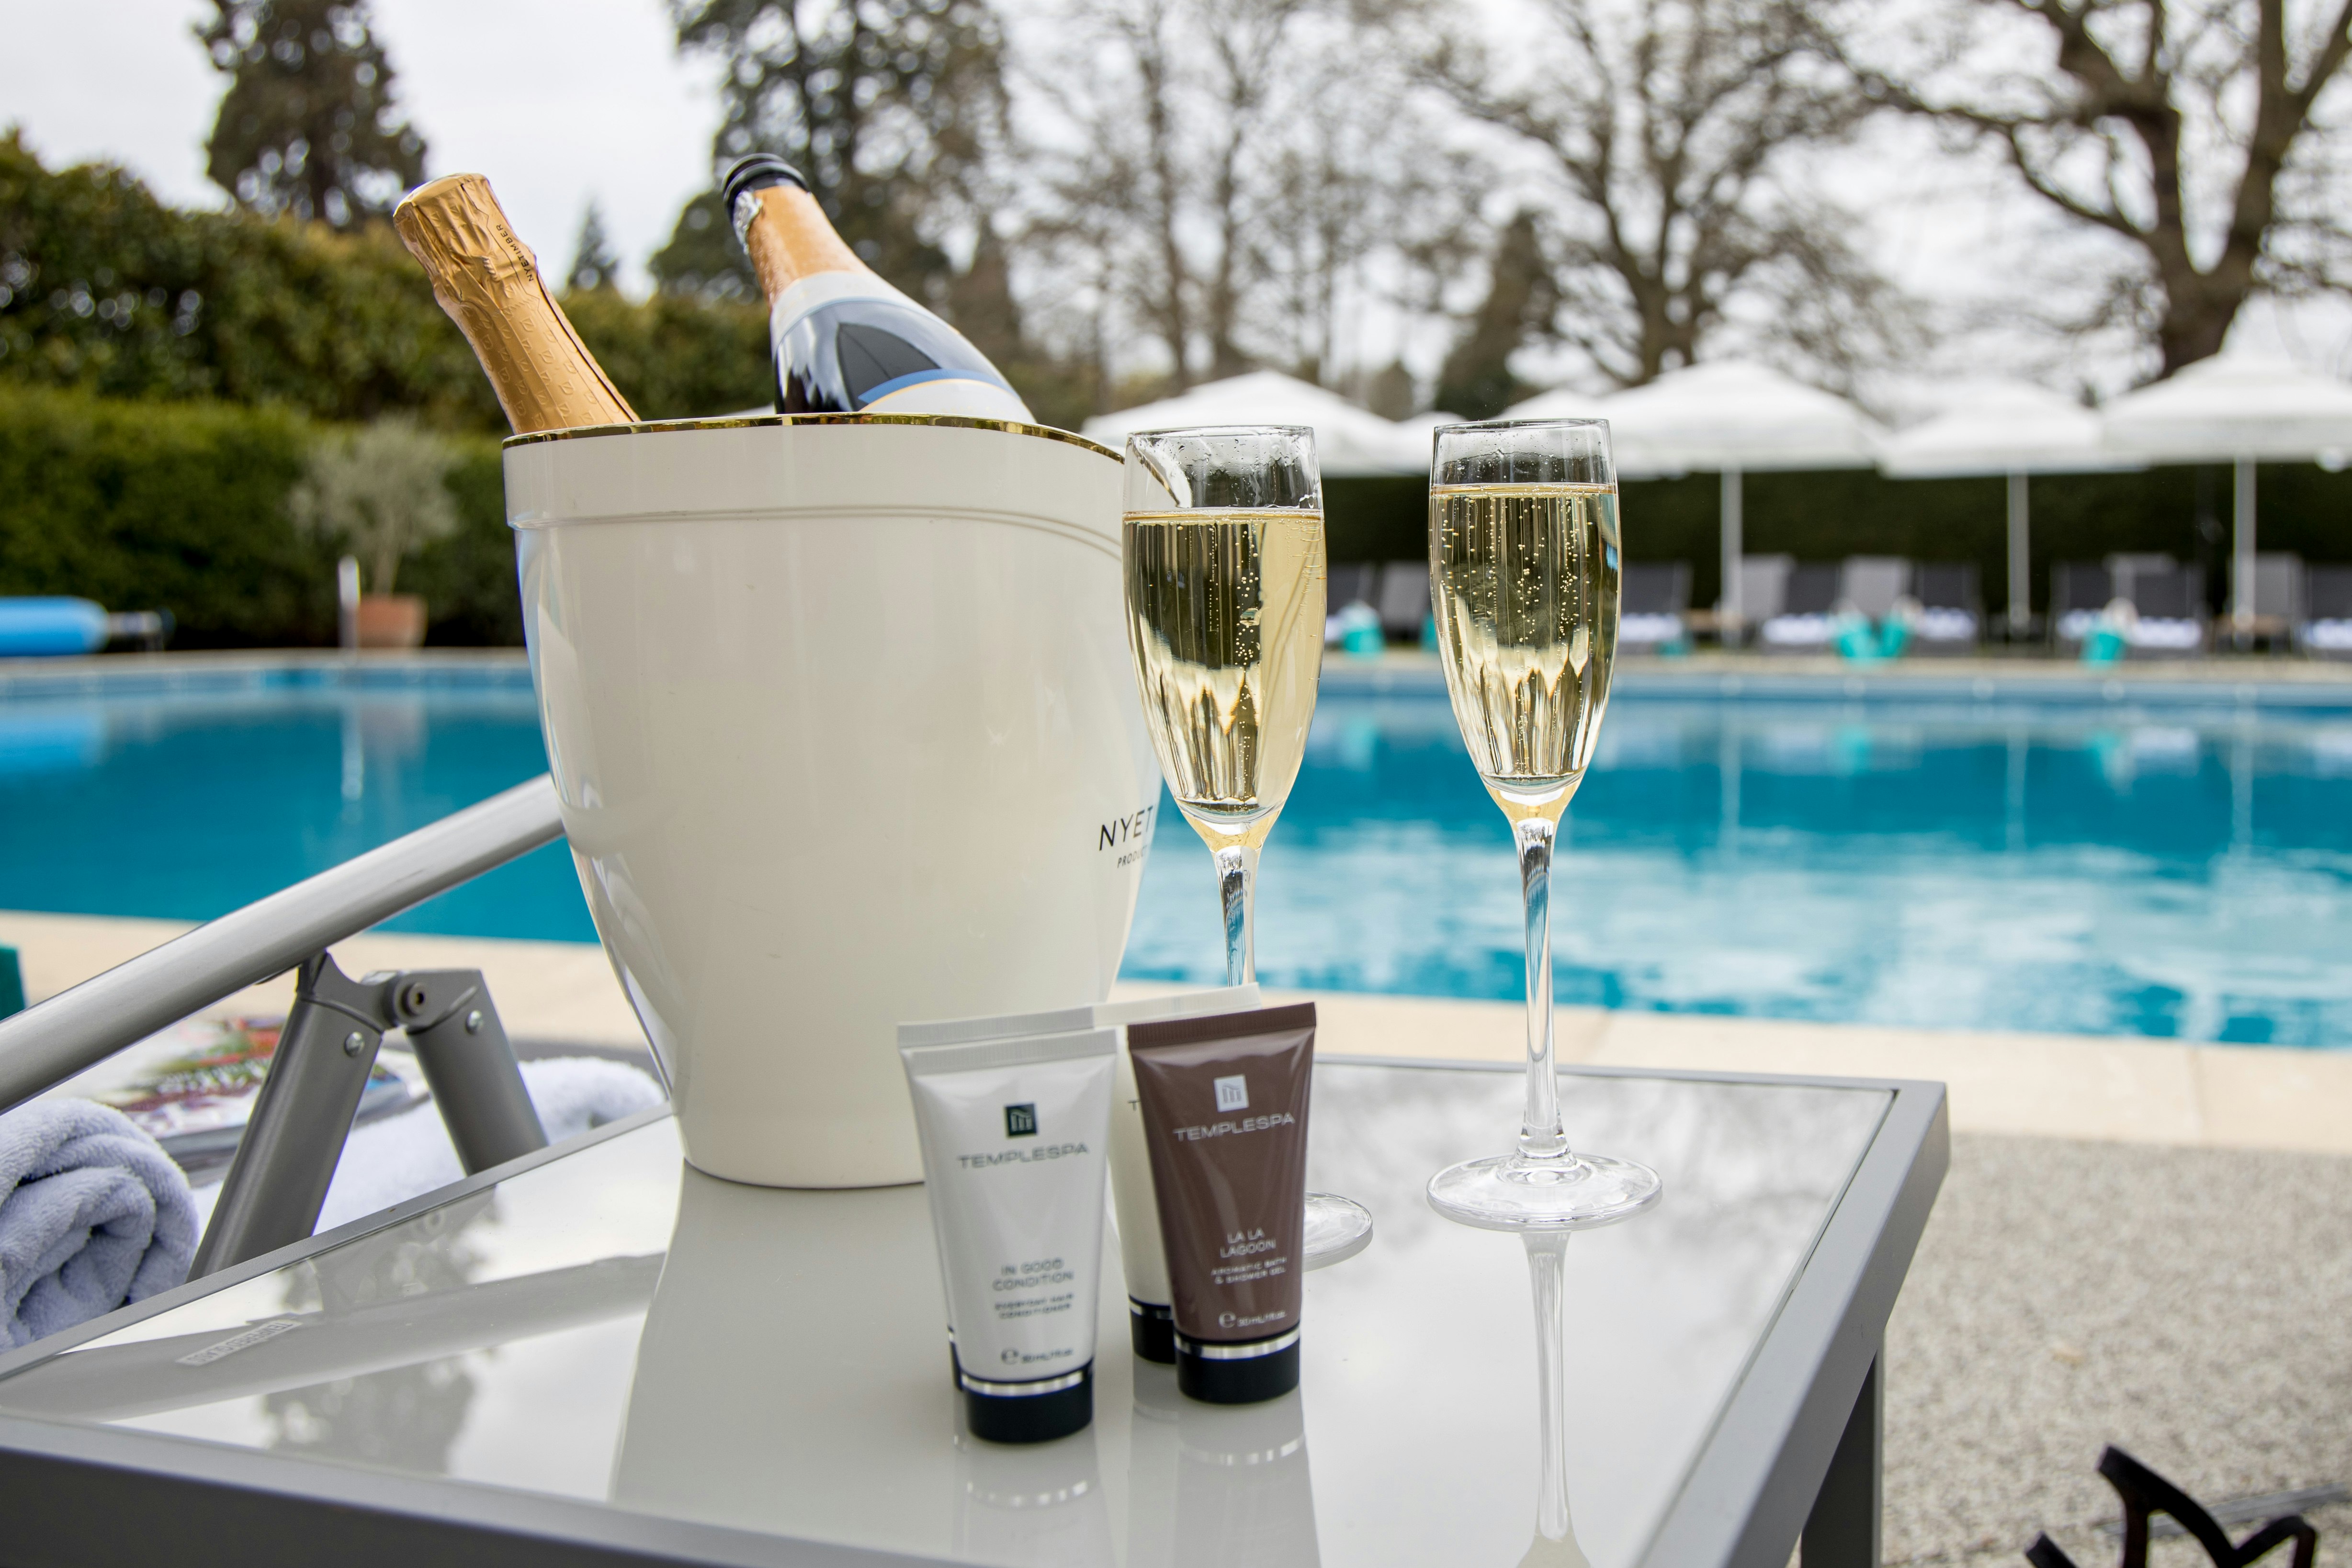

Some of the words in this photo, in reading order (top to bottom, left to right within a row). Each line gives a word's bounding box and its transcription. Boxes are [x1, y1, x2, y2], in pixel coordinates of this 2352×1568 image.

[496, 224, 534, 282] NYETIMBER
[1172, 1112, 1296, 1142] TEMPLESPA
[957, 1141, 1090, 1169] TEMPLESPA
[1227, 1230, 1245, 1244] LA
[1247, 1227, 1266, 1241] LA
[1220, 1237, 1277, 1258] LAGOON
[1001, 1264, 1017, 1276] IN
[1020, 1257, 1065, 1275] GOOD
[992, 1271, 1074, 1291] CONDITION
